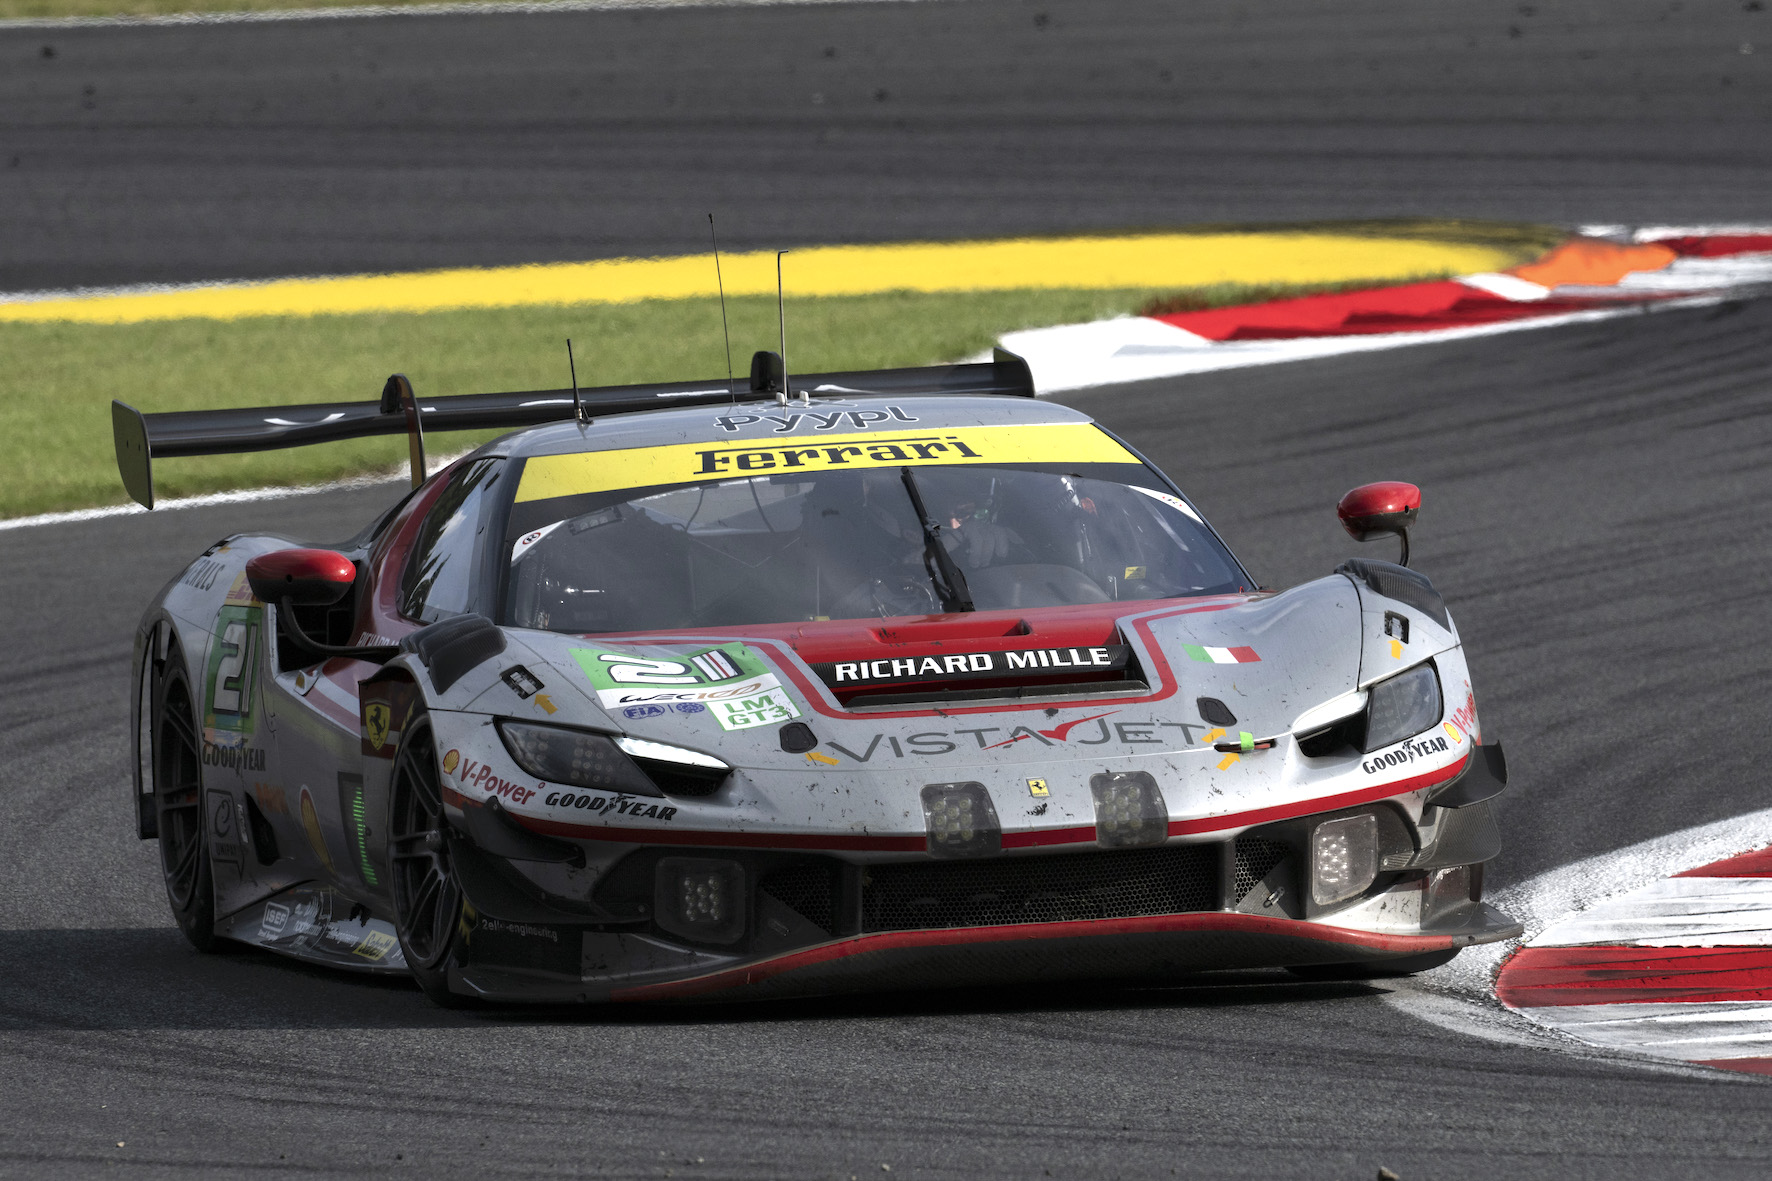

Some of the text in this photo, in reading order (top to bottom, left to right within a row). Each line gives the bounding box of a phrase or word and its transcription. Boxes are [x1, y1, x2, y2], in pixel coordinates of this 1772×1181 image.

[693, 436, 983, 475] Ferrari
[835, 647, 1112, 682] RICHARD MILLE
[624, 704, 662, 719] FIA
[724, 695, 775, 714] LM
[726, 705, 789, 725] GT3
[461, 758, 536, 805] V-Power
